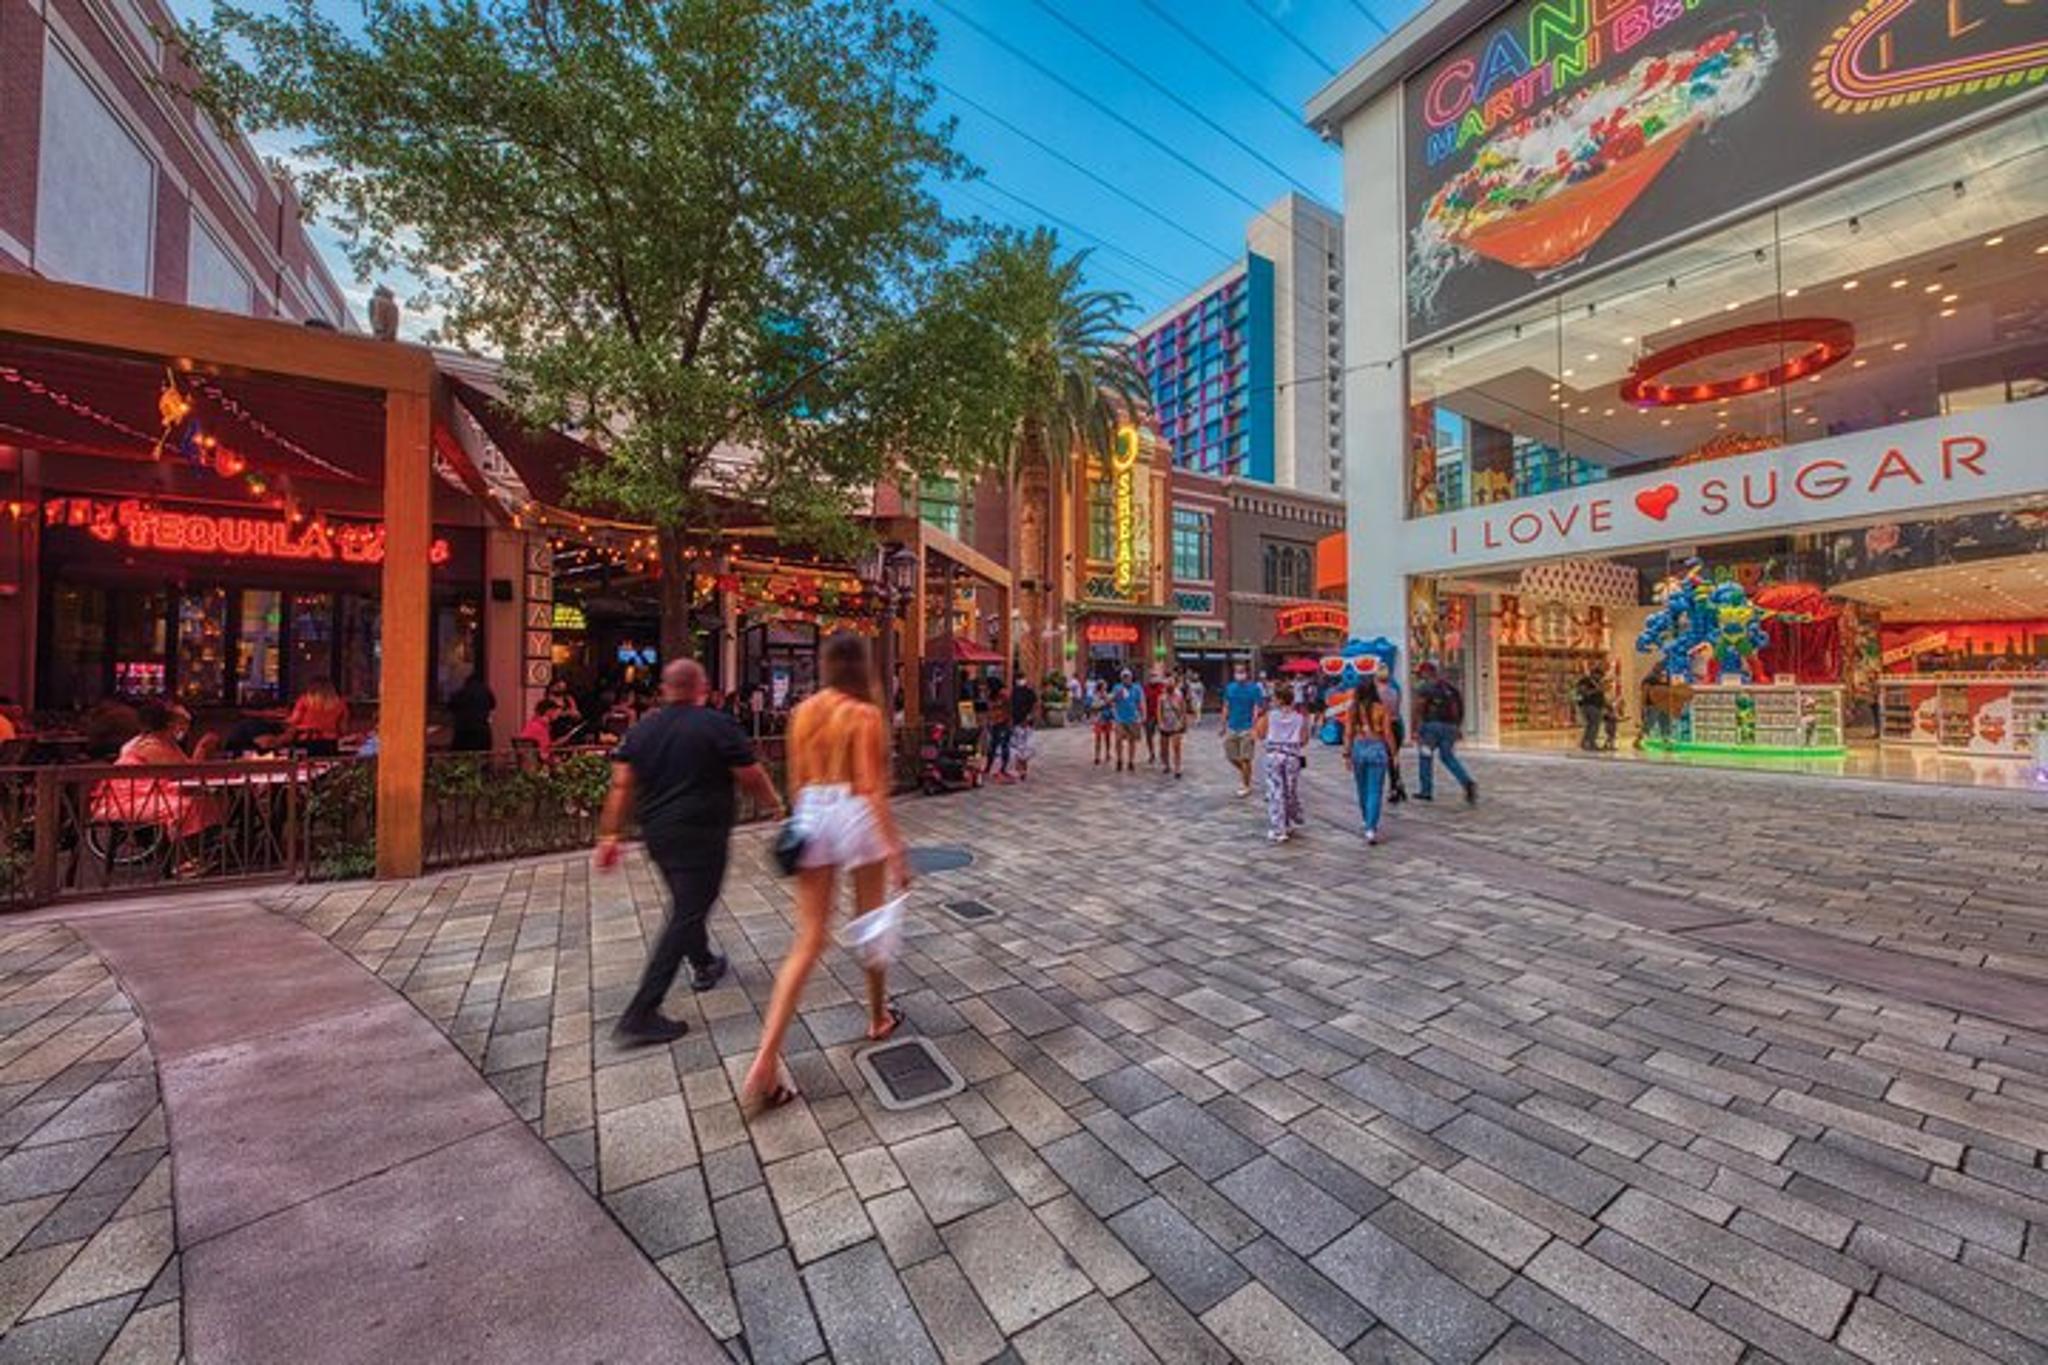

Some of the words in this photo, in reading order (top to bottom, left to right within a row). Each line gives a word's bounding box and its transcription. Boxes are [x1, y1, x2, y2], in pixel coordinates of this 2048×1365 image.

[1426, 31, 1600, 166] MARTINI
[129, 511, 335, 559] TEQUILA
[1450, 526, 1458, 554] I
[1484, 499, 1613, 549] LOVE
[1701, 436, 1988, 516] SUGAR
[529, 546, 551, 684] CHAYO
